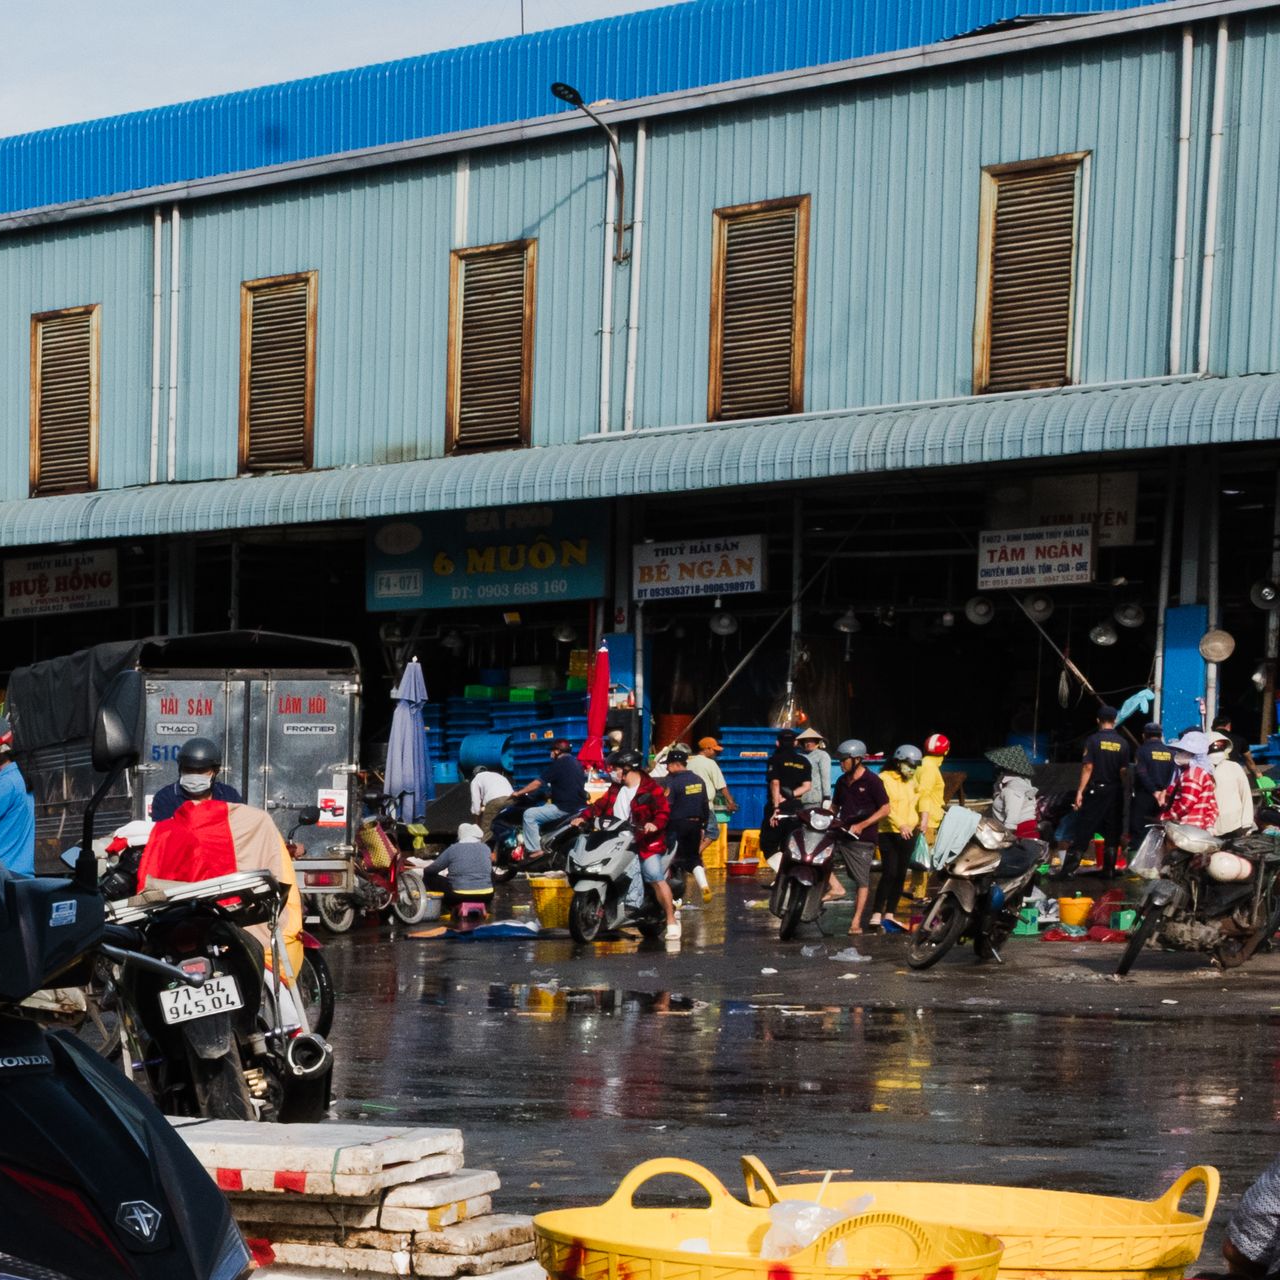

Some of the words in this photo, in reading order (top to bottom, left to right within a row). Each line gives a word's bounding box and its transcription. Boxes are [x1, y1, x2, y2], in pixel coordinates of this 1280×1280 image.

[432, 551, 455, 576] 6
[465, 534, 590, 575] MUÔN
[987, 545, 1026, 564] TÂM
[1035, 540, 1083, 560] NGÂN
[639, 558, 671, 585] BÉ
[678, 553, 755, 582] NGÂN
[8, 572, 49, 598] HUỆ
[477, 583, 510, 598] 0903
[544, 578, 568, 594] 160
[161, 692, 178, 715] HẢI
[187, 692, 213, 716] SẢN
[160, 725, 195, 733] THACO
[286, 725, 336, 733] FRONTIER
[169, 980, 226, 1005] 71-B4
[169, 994, 236, 1020] 945.04
